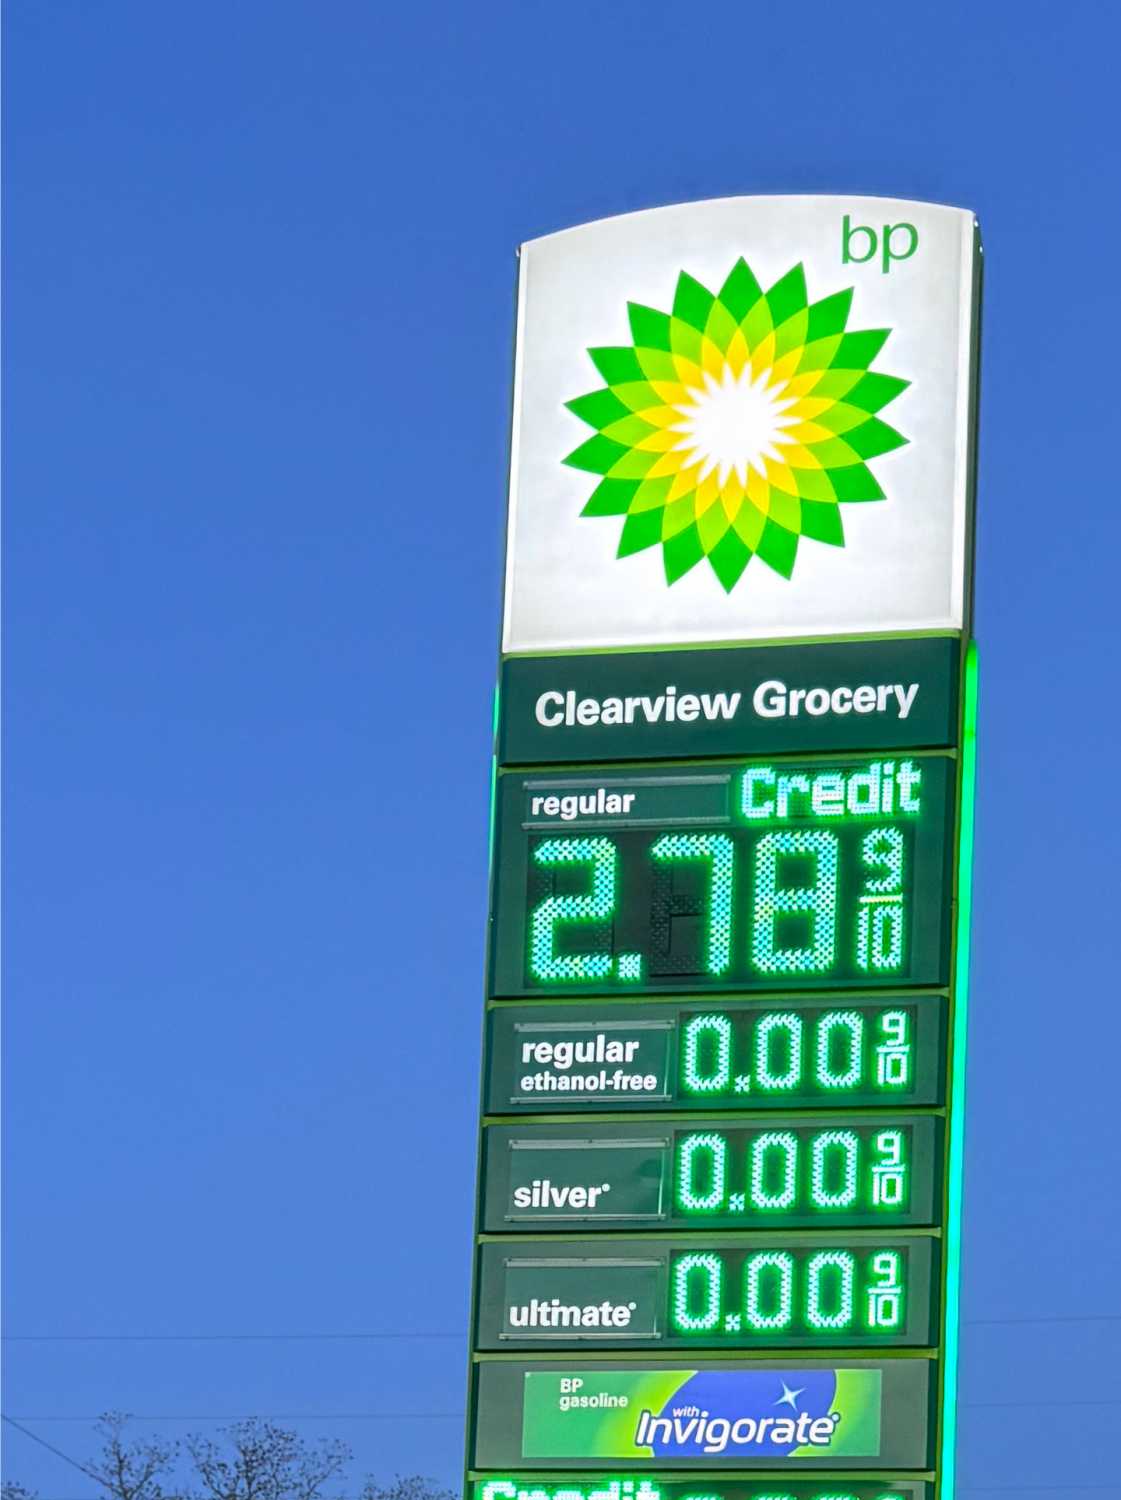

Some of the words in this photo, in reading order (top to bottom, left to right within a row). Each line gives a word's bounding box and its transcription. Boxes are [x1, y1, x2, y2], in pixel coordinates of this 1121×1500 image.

[841, 215, 919, 273] bp
[535, 685, 741, 727] Clearview
[753, 680, 919, 718] Grocery
[531, 788, 635, 820] regular
[740, 761, 921, 818] Credit
[530, 829, 839, 981] 2.78
[521, 1035, 639, 1068] regular
[685, 1010, 863, 1093] 0.00
[520, 1070, 657, 1092] ethanol-free
[680, 1130, 858, 1211] 0.00
[674, 1250, 853, 1331] 0.00
[559, 1394, 628, 1411] gasoline
[560, 1379, 583, 1393] BP
[635, 1411, 834, 1453] Invigorate
[673, 1406, 699, 1417] with
